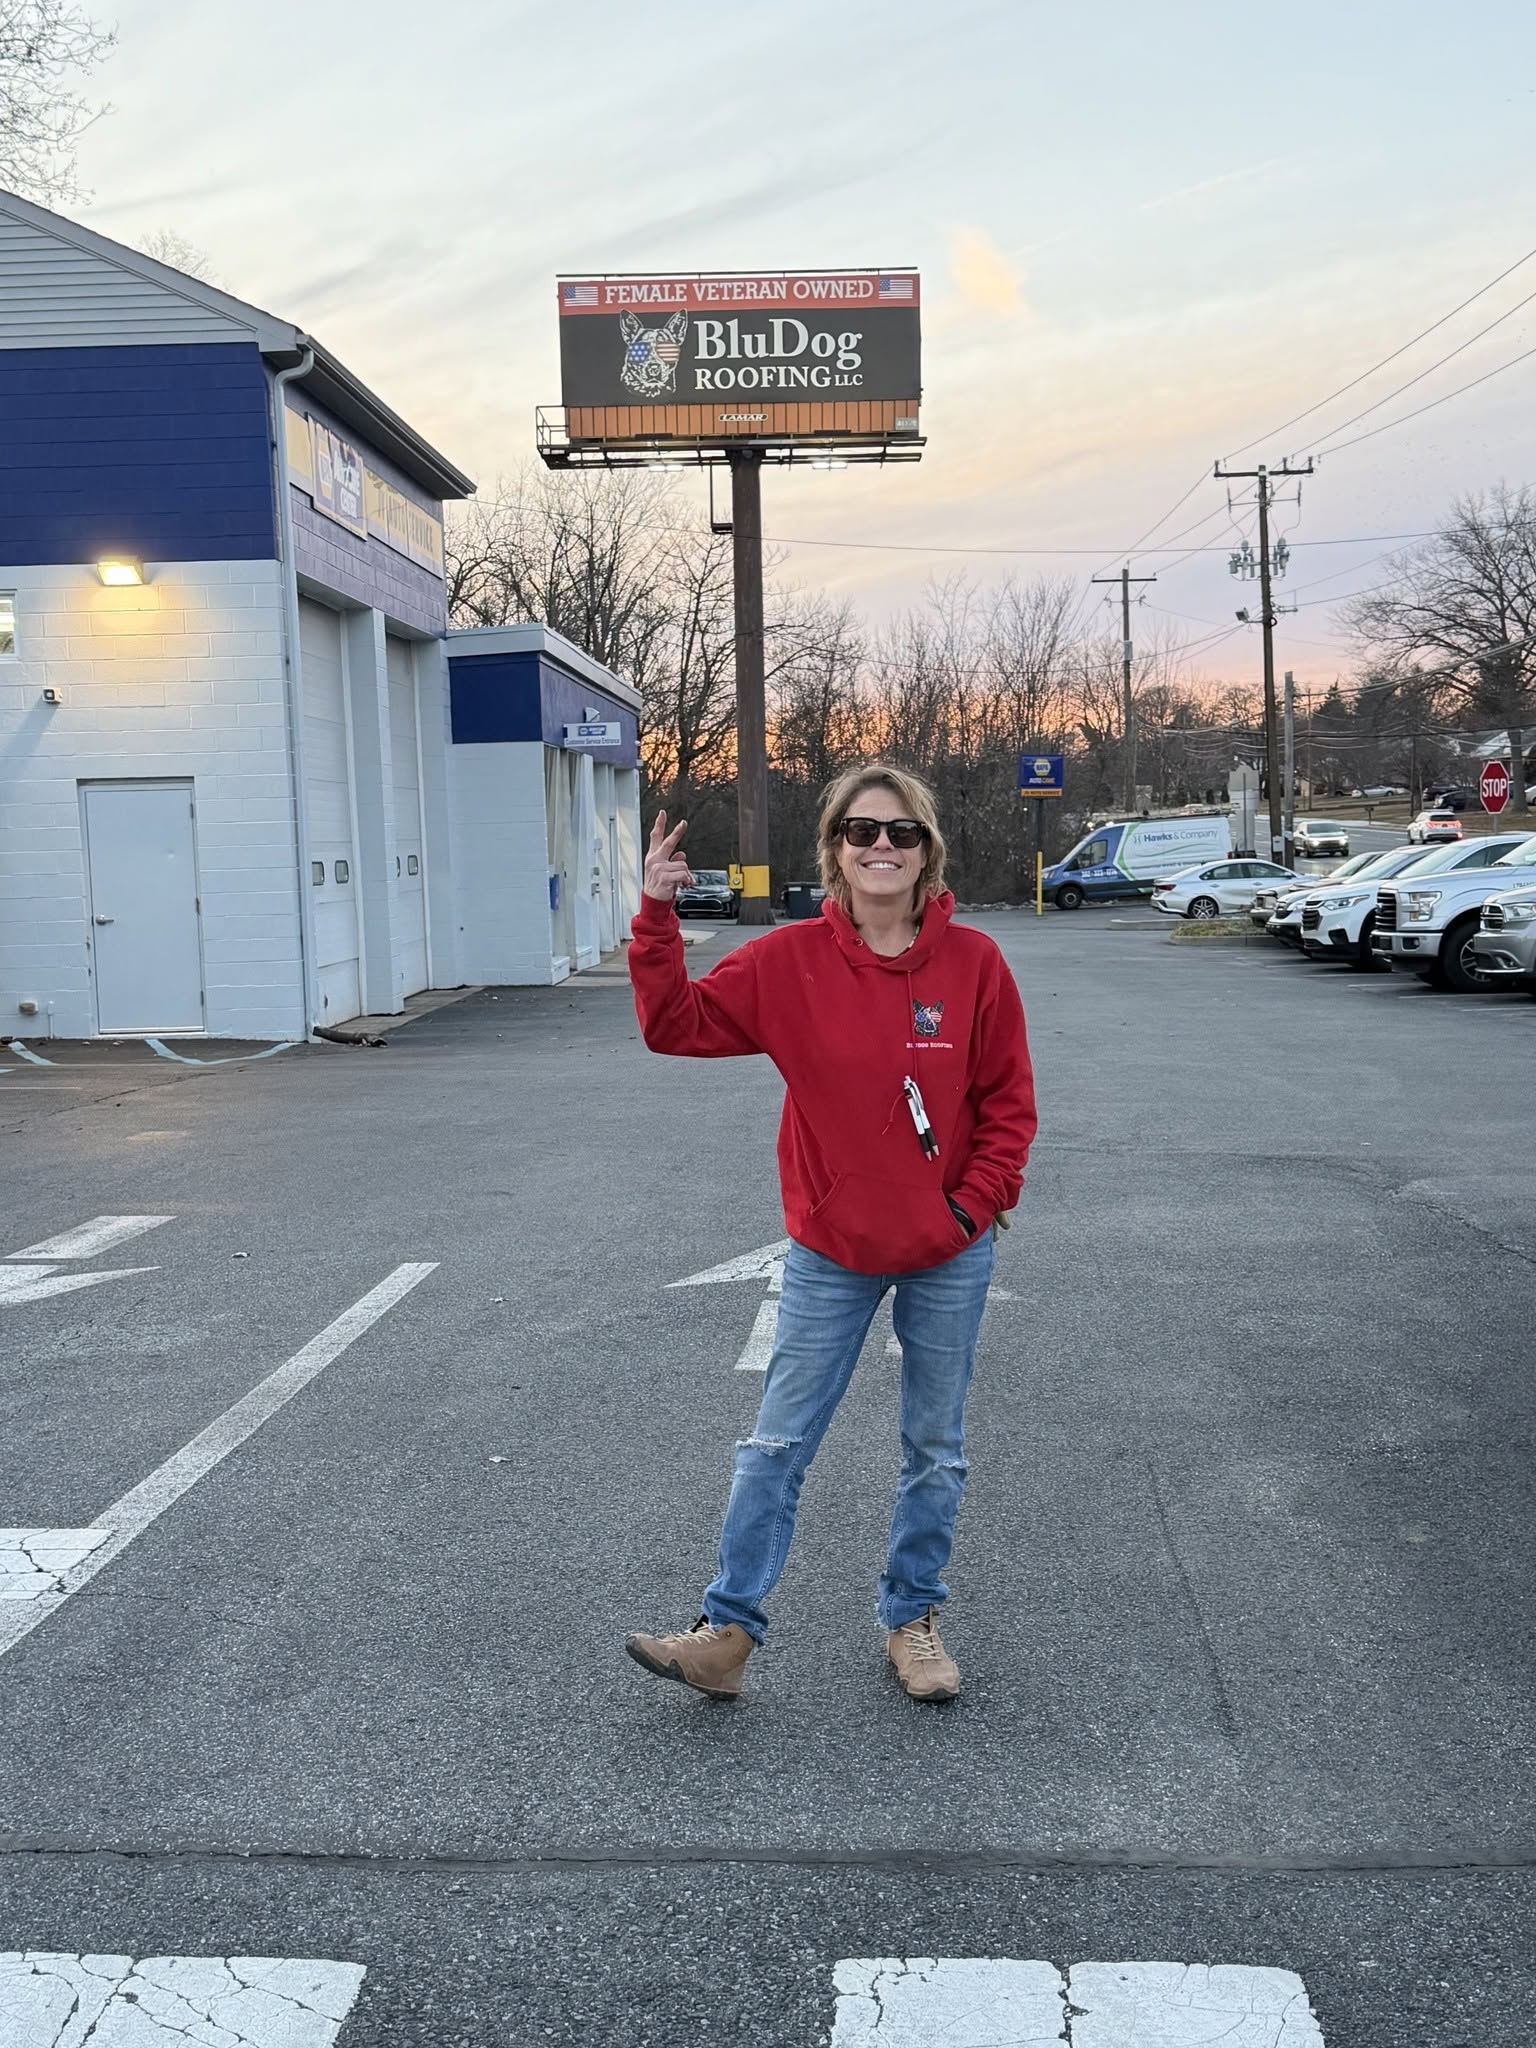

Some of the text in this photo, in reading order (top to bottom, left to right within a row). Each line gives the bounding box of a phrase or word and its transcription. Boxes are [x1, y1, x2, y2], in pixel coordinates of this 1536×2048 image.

[605, 279, 874, 304] FEMALE VETERAN OWNED
[693, 318, 863, 370] BluDog
[694, 366, 863, 390] ROOFING LLC
[722, 413, 764, 421] LAMAR
[1482, 778, 1507, 798] STOP
[1144, 833, 1173, 842] Hawks
[1180, 830, 1217, 840] Company
